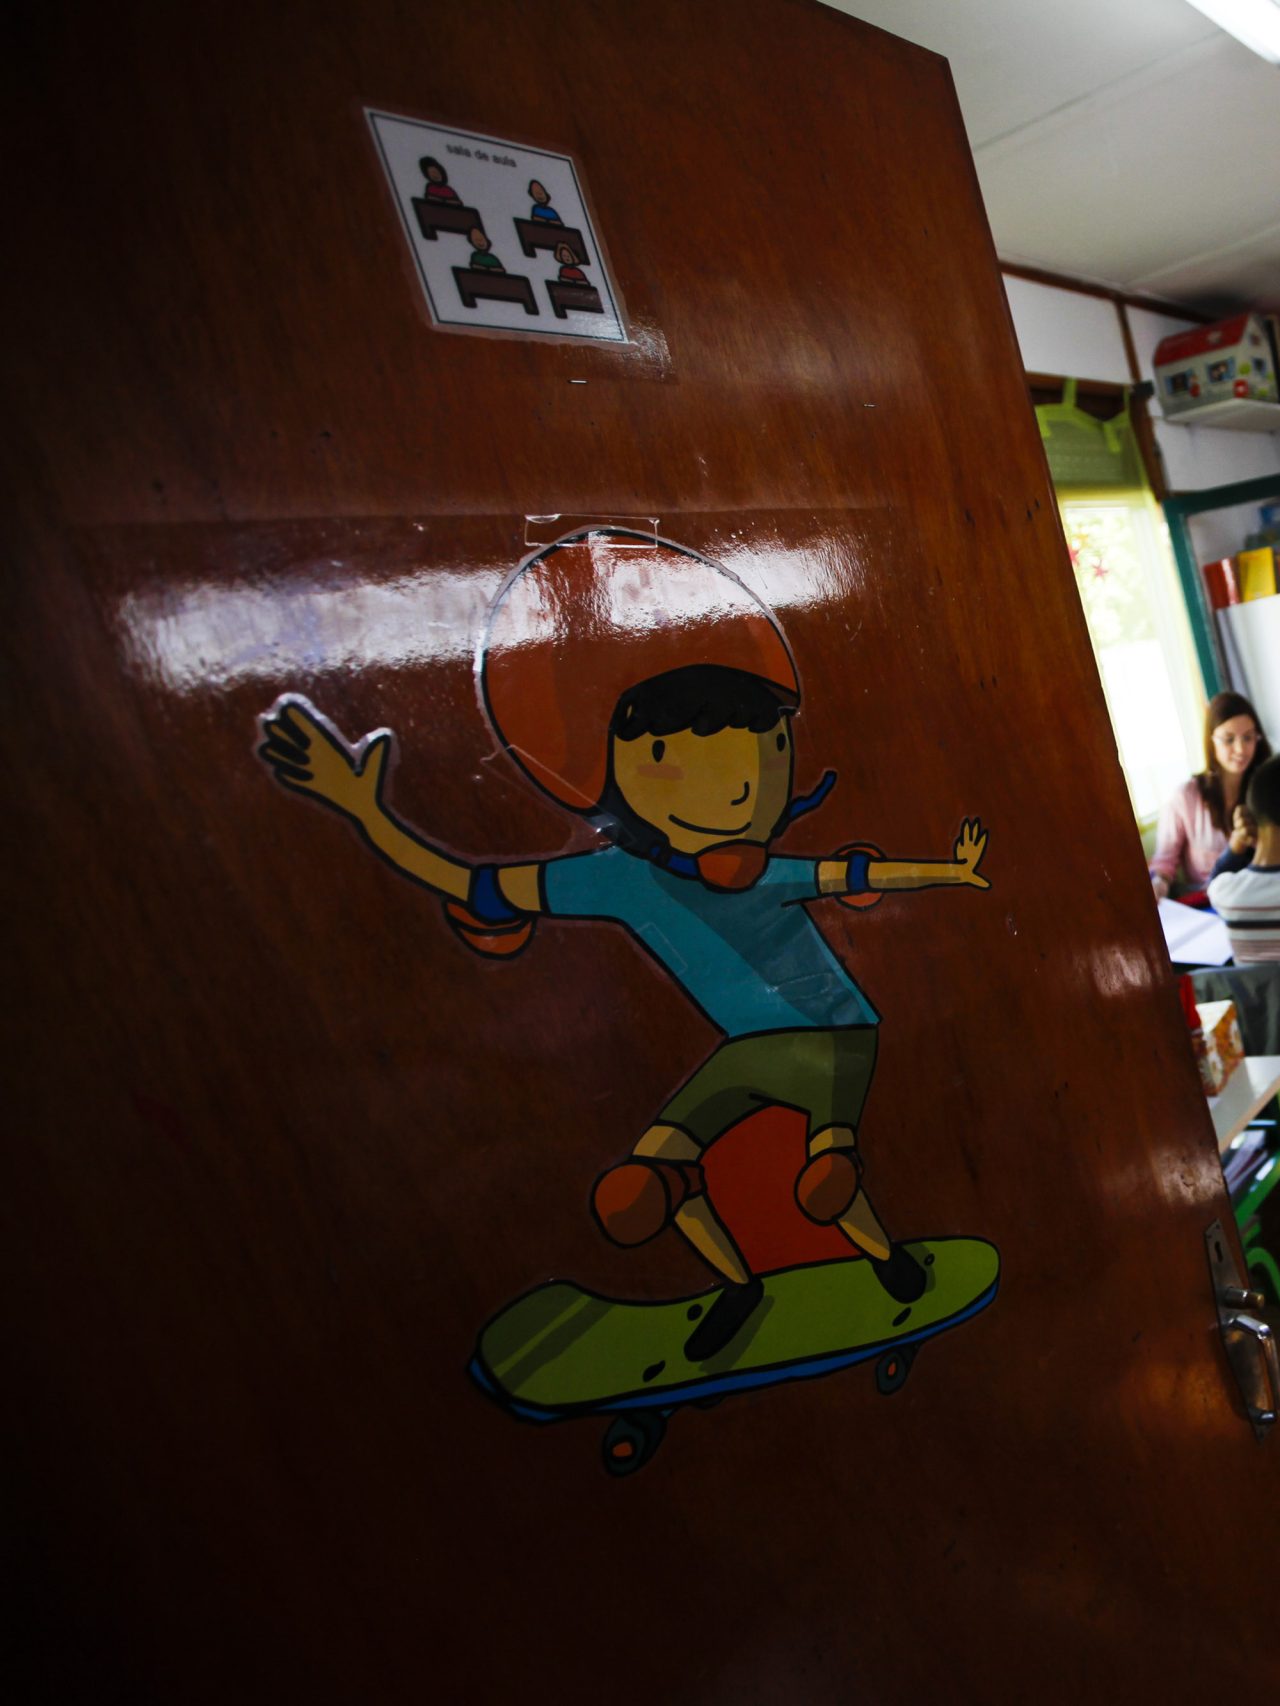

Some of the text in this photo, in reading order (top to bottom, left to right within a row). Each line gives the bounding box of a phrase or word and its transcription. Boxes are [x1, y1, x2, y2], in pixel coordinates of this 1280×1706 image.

[446, 143, 517, 168] sala de aula
